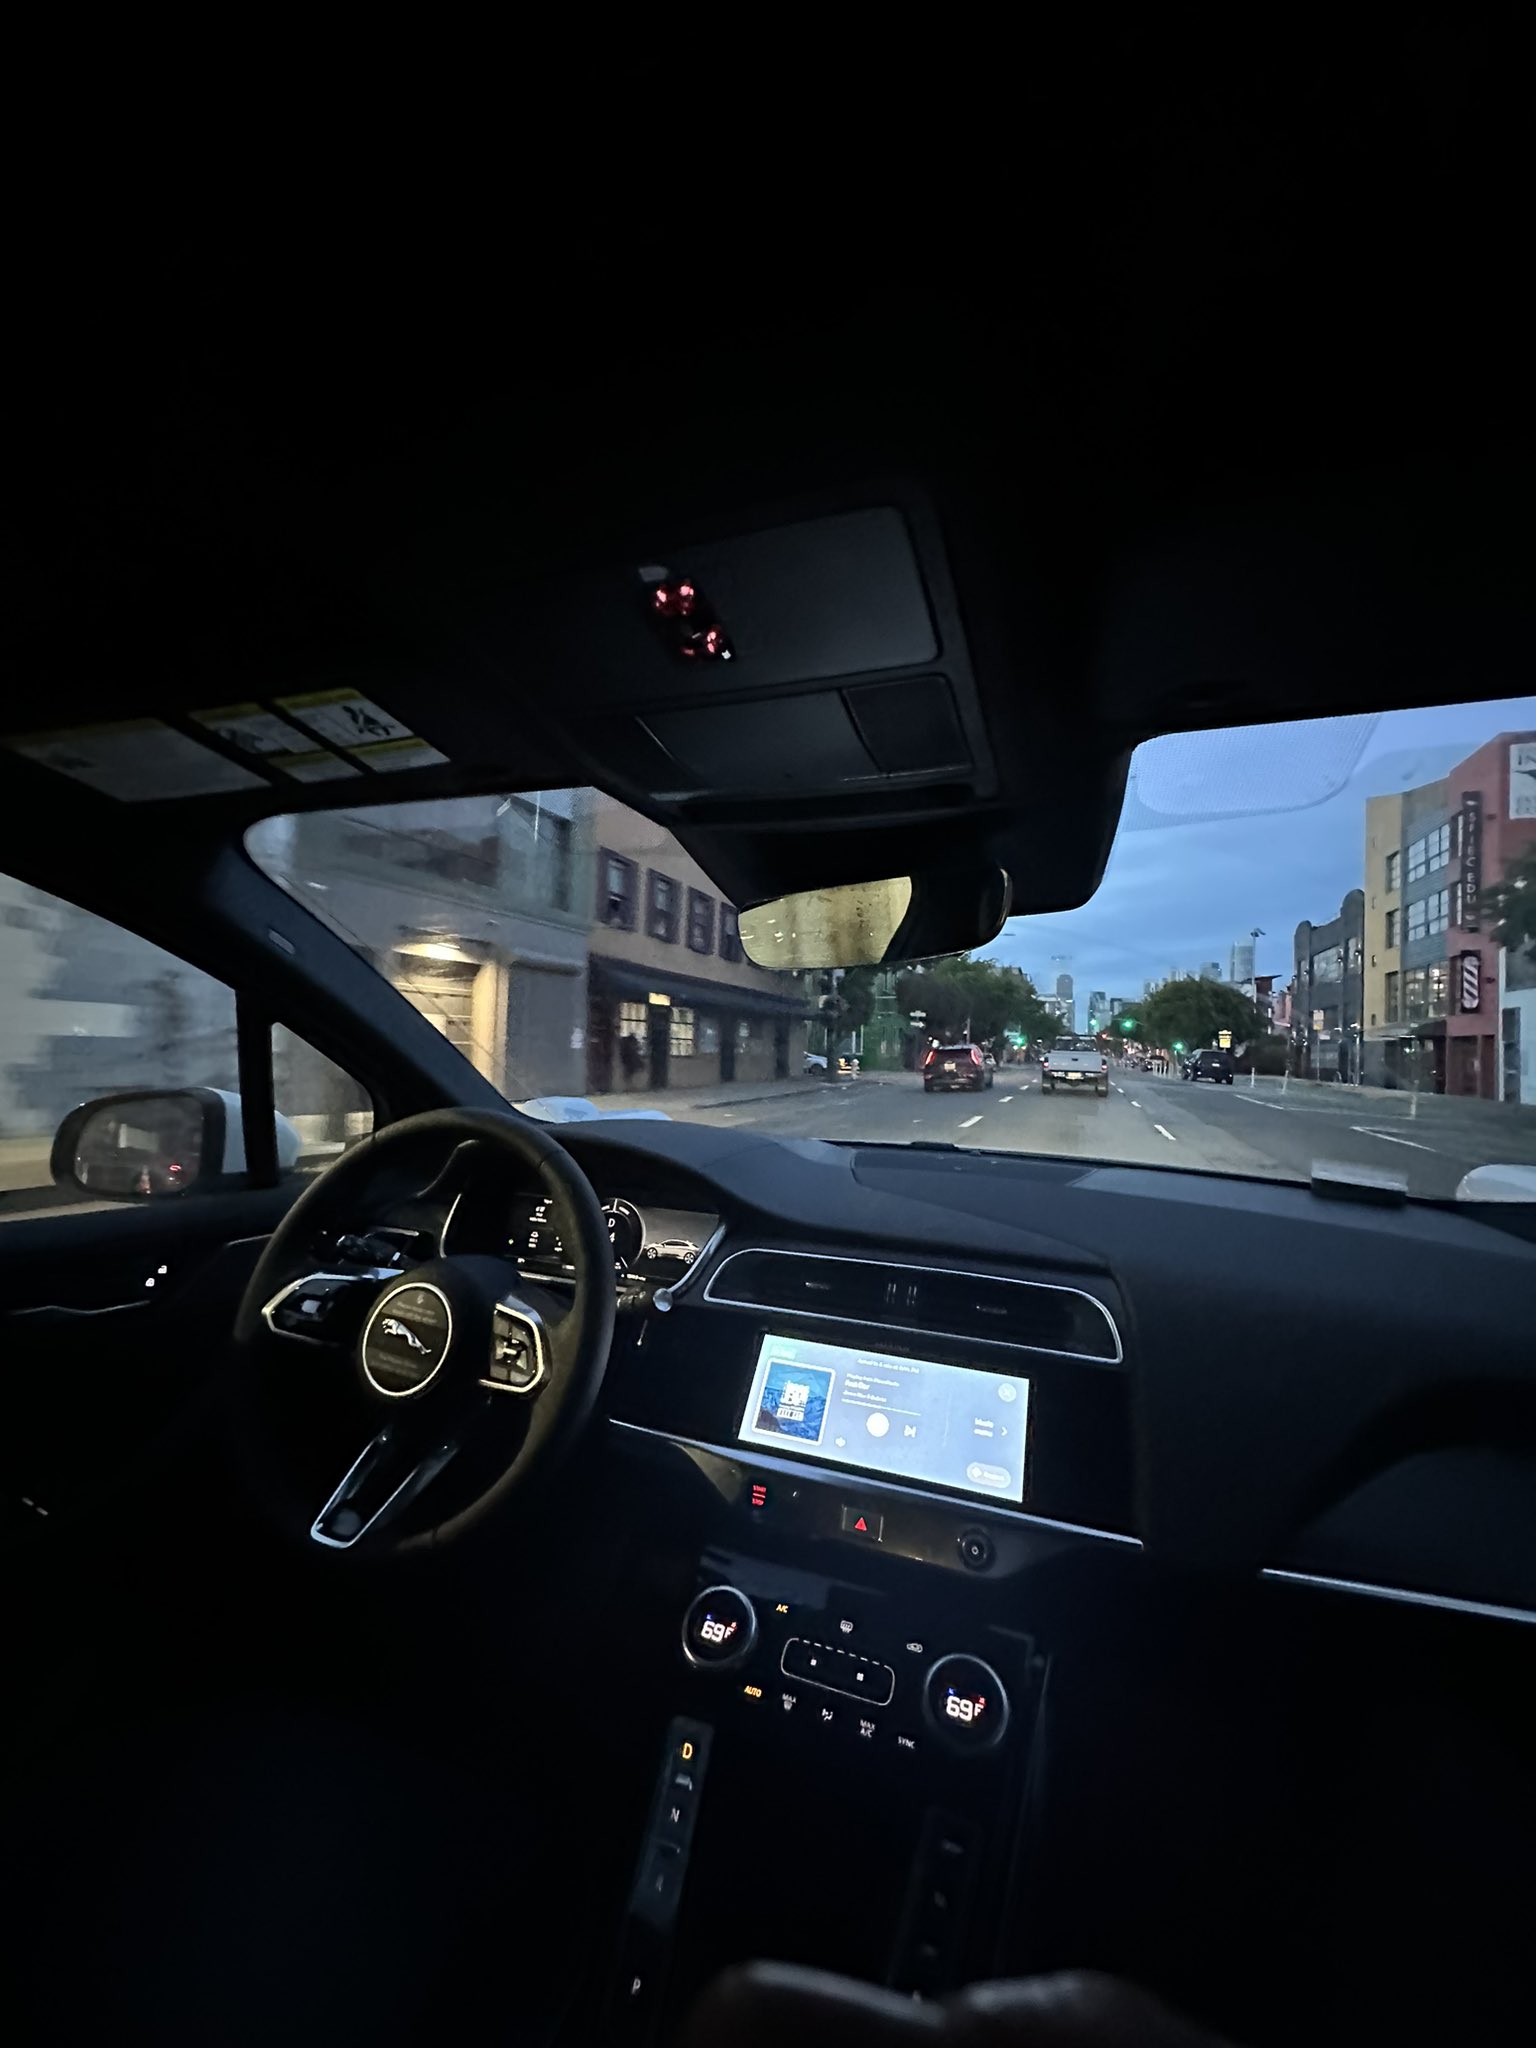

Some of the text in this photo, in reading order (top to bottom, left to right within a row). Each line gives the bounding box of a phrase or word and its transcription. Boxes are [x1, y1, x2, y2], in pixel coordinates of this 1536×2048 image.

[608, 1218, 616, 1228] D
[776, 1603, 788, 1614] A/C
[744, 1685, 762, 1698] AUTO
[860, 1718, 876, 1731] MAX
[859, 1727, 873, 1739] A/C
[897, 1735, 916, 1750] SYNC
[681, 1742, 693, 1760] D
[670, 1808, 680, 1823] N
[632, 1978, 641, 1995] P
